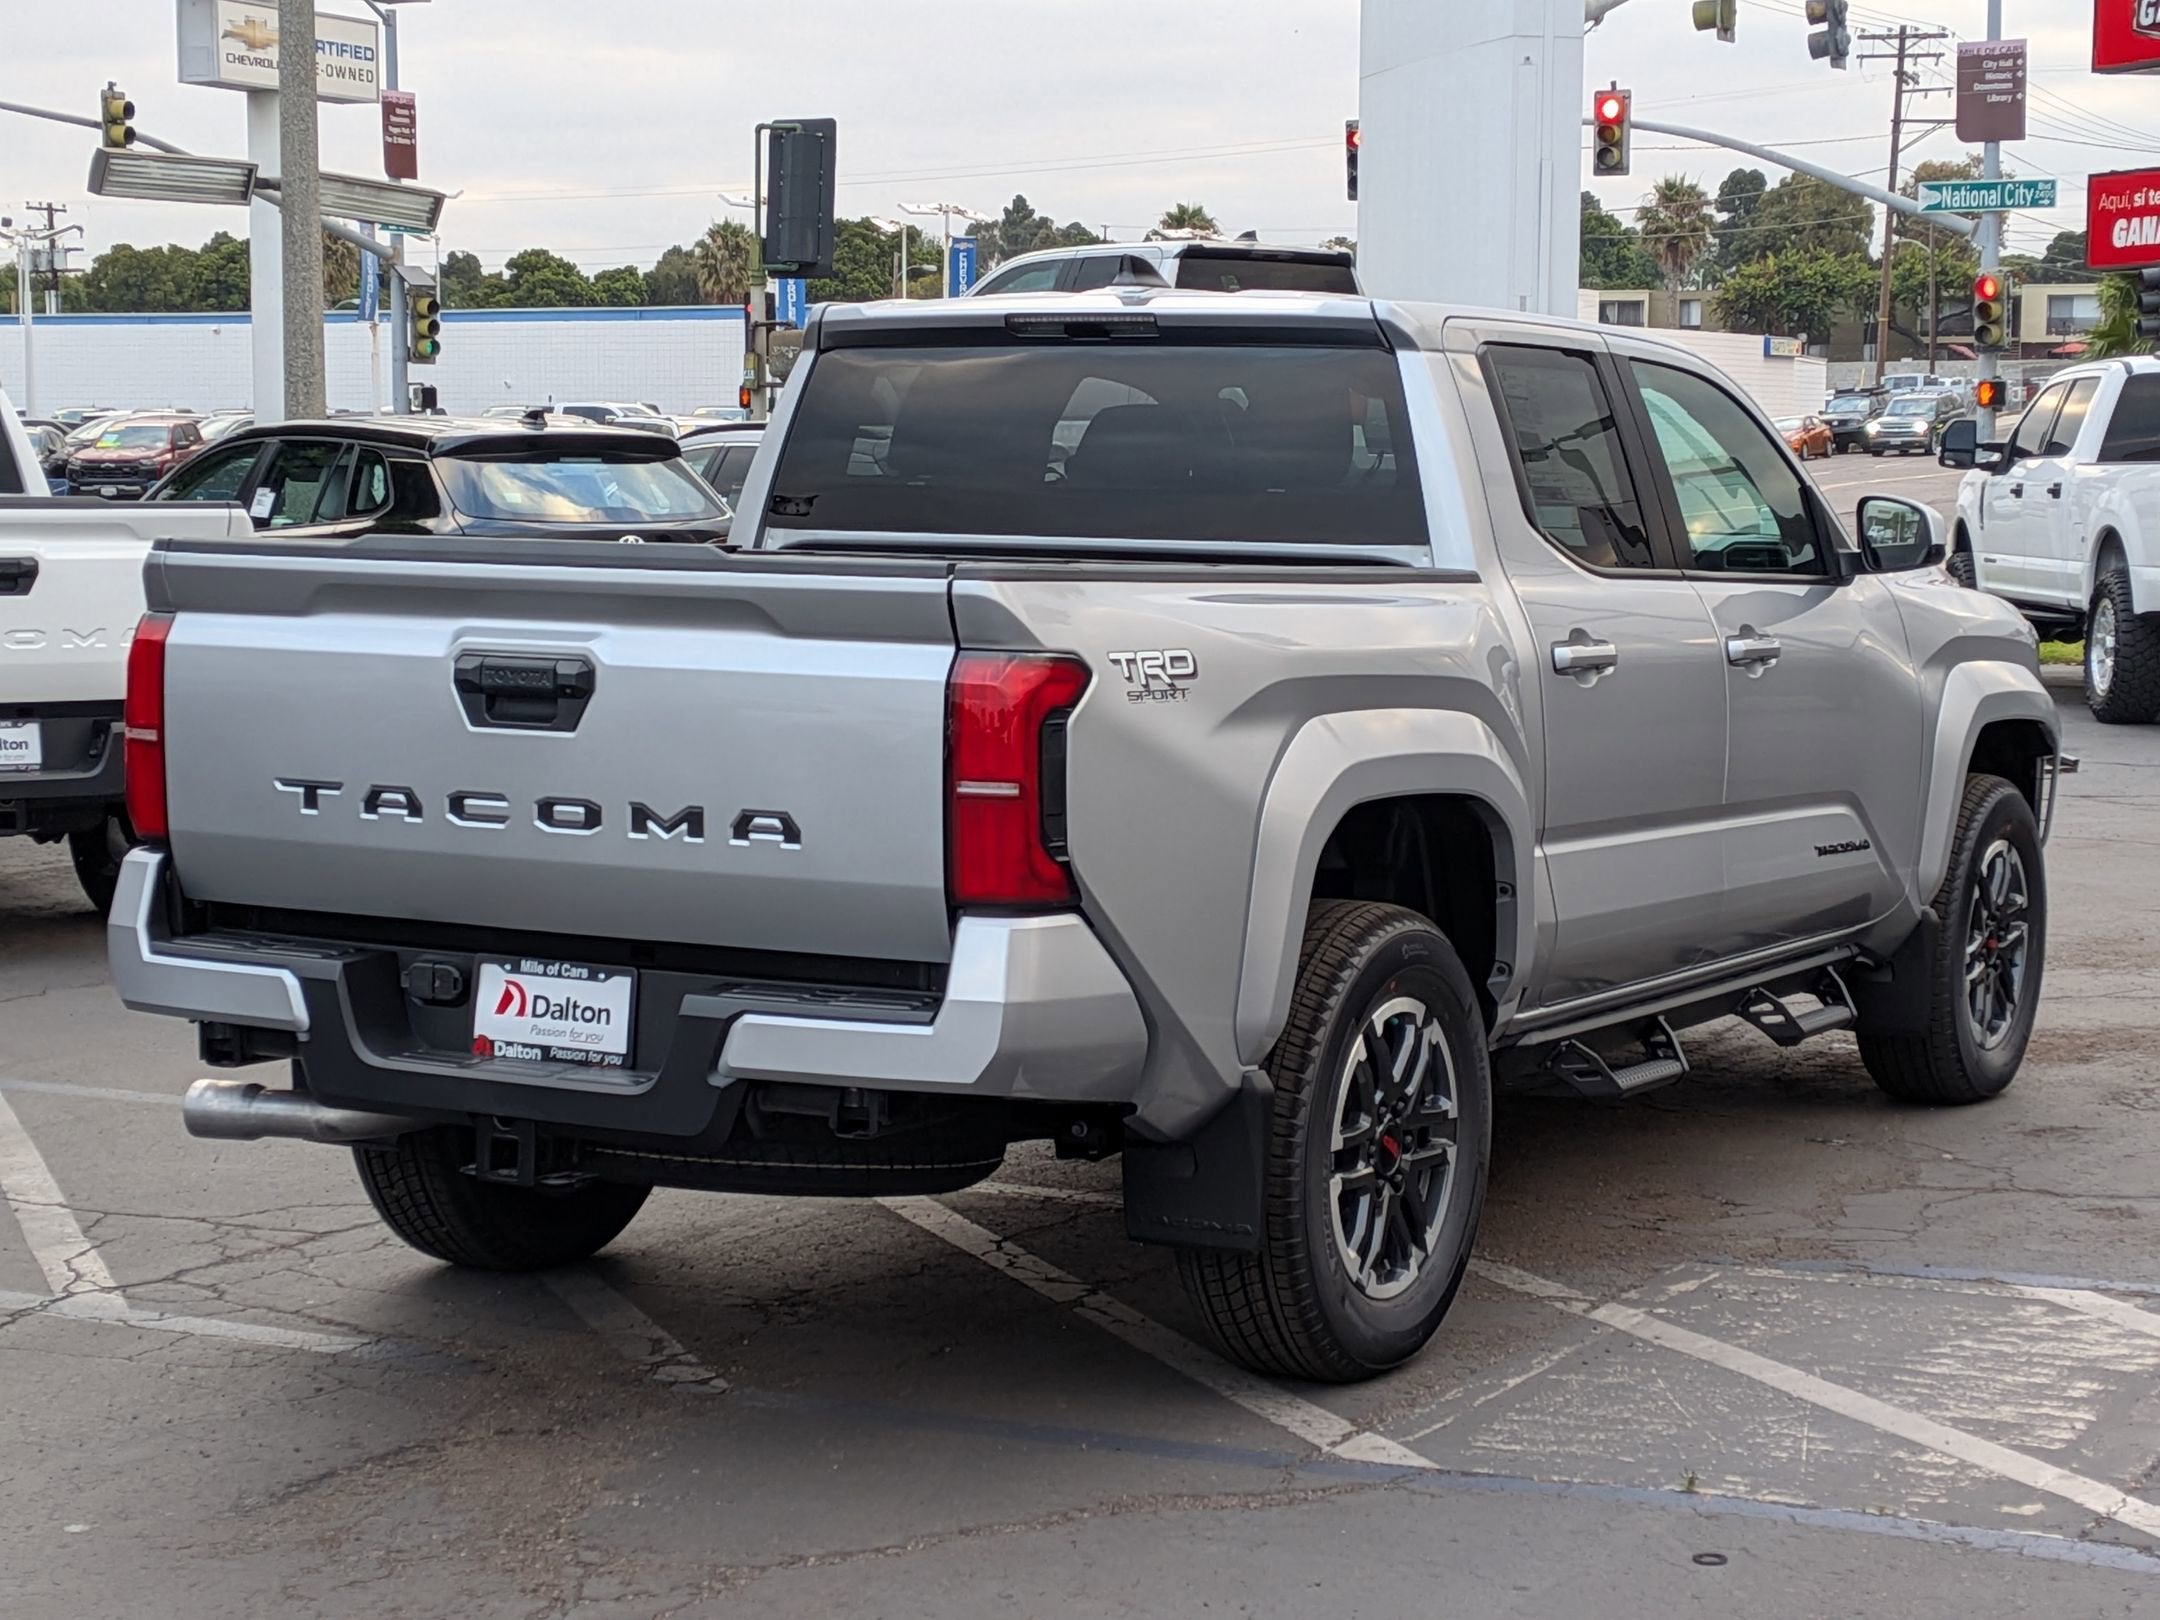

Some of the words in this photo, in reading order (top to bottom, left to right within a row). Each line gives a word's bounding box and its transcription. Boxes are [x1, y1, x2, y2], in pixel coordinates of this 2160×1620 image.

[226, 52, 279, 70] CHEVROL
[1982, 60, 1997, 70] City
[1941, 185, 2000, 208] National
[2005, 183, 2034, 206] City
[2133, 187, 2147, 207] sí
[2112, 216, 2160, 248] GAN
[484, 669, 551, 686] TOYOTA
[1107, 648, 1198, 688] TRD
[1127, 687, 1191, 704] SPORT
[274, 777, 802, 850] TACOMA
[520, 959, 544, 974] Mile
[546, 962, 560, 976] of
[561, 963, 589, 979] Cars
[531, 994, 611, 1026] Dalton
[529, 1024, 566, 1038] Passion
[569, 1029, 583, 1042] for
[585, 1032, 604, 1042] you
[494, 1040, 542, 1061] Dalton
[549, 1046, 585, 1061] Passion
[587, 1051, 602, 1062] for
[603, 1054, 623, 1066] you
